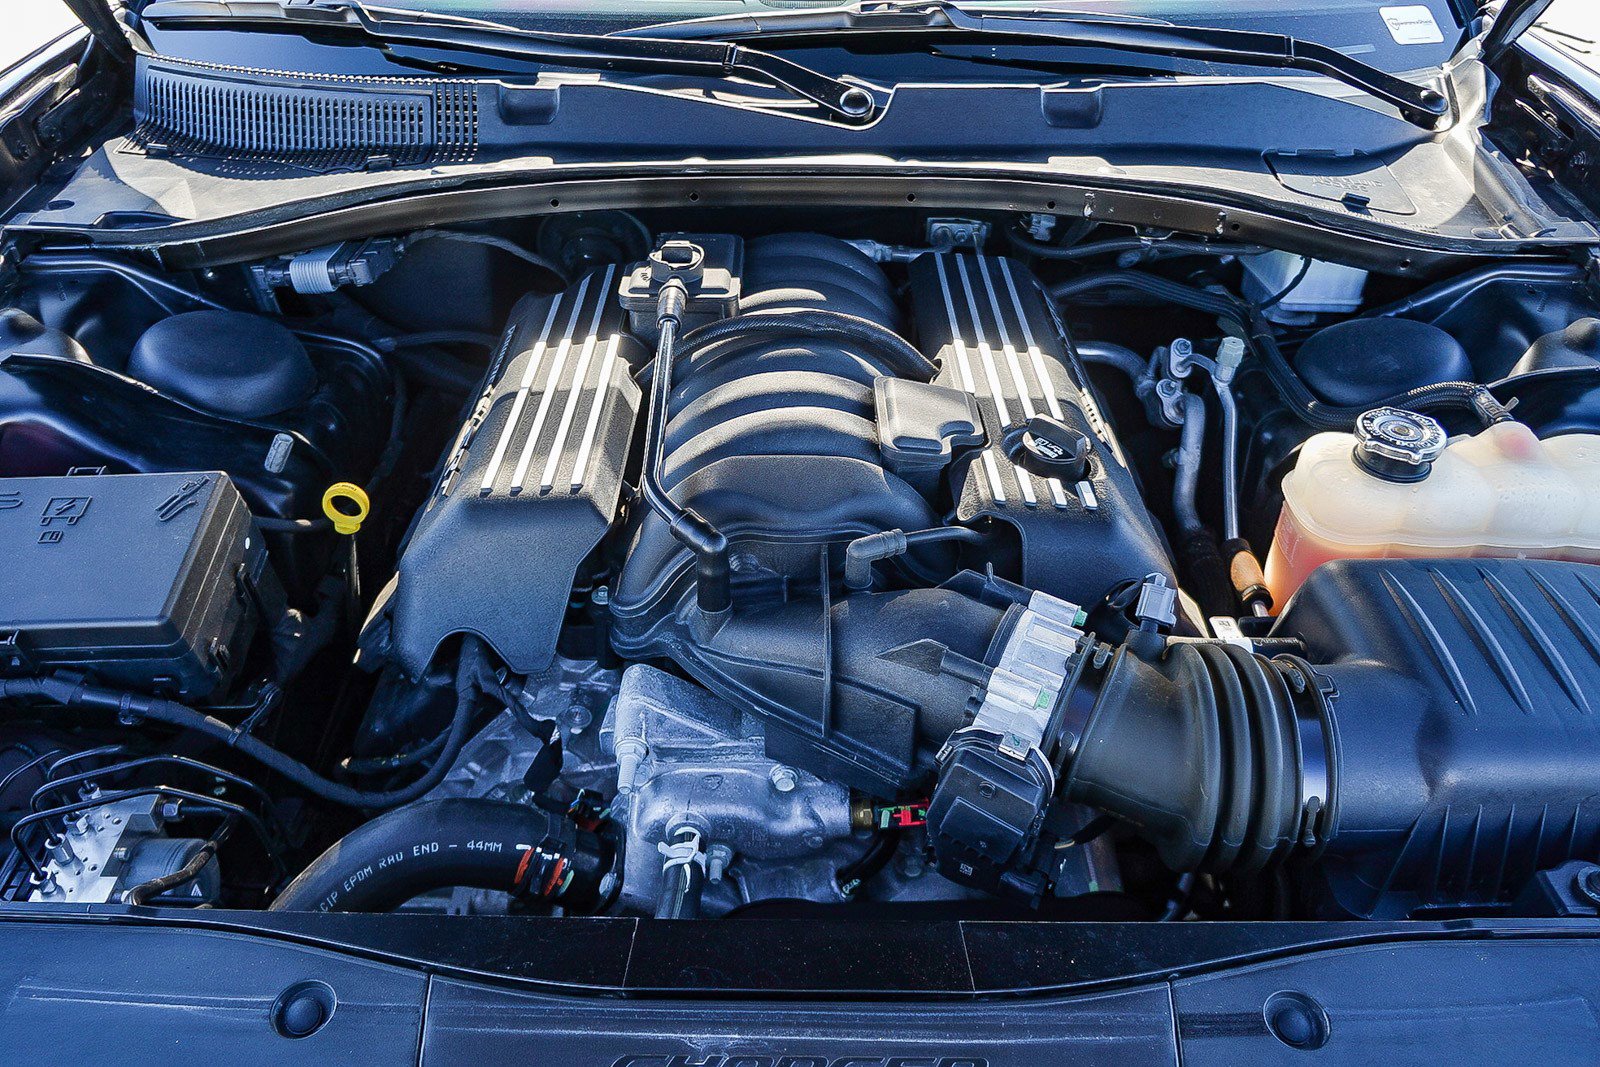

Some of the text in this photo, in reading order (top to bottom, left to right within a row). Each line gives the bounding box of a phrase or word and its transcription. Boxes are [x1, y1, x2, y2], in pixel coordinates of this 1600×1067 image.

[343, 865, 373, 892] EPDM
[413, 842, 439, 857] END
[466, 839, 503, 854] 44MM
